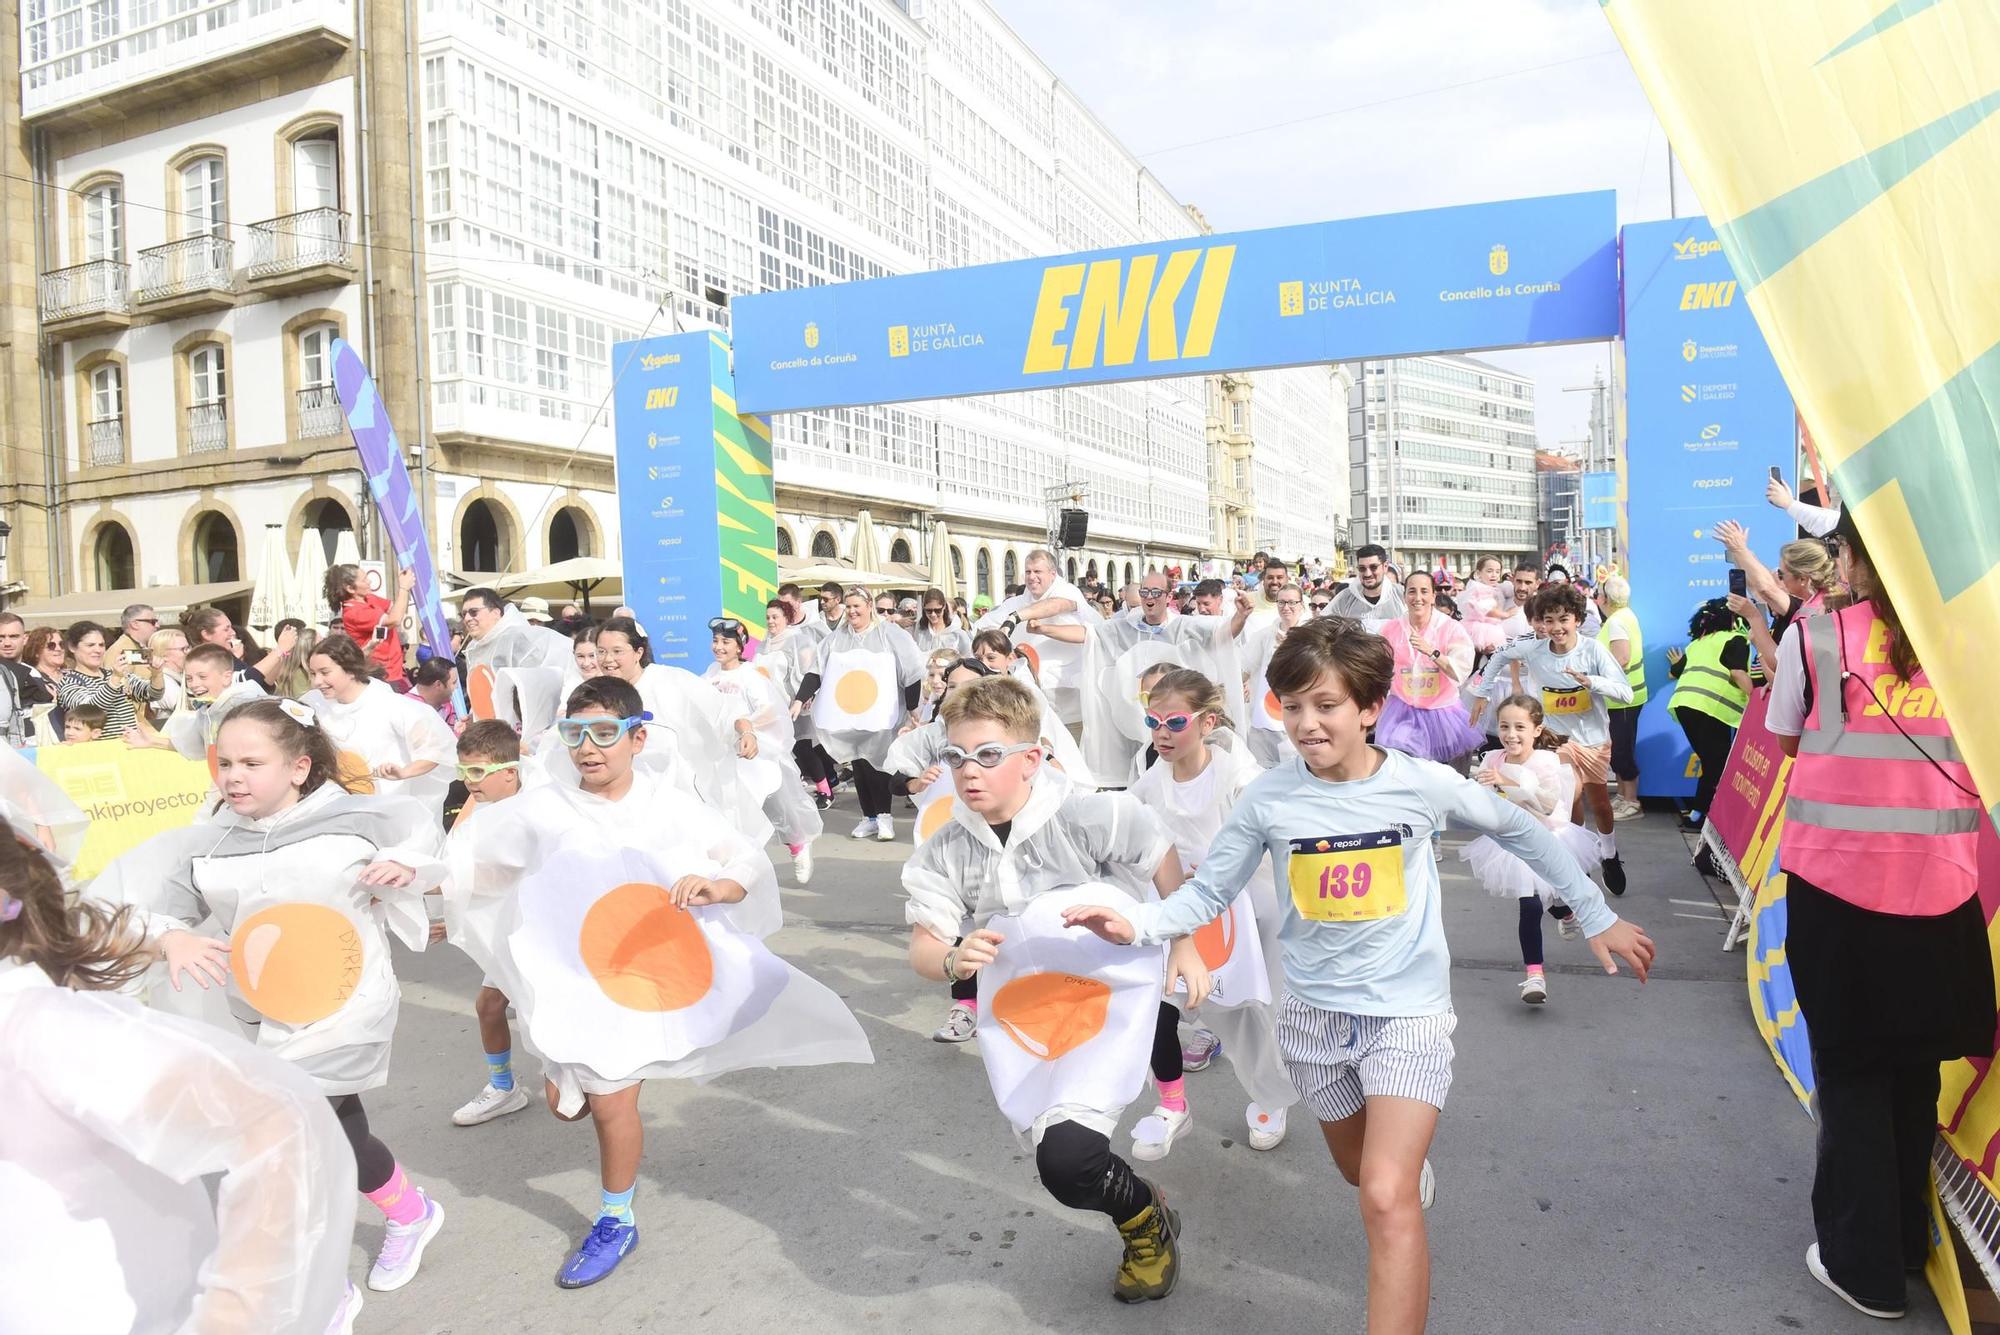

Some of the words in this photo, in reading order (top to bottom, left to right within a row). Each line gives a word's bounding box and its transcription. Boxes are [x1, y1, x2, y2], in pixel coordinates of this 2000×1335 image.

[1672, 237, 1721, 256] Vega
[1309, 278, 1361, 295] XUNTA
[1440, 287, 1491, 302] Concello
[1496, 285, 1511, 297] da
[1515, 281, 1560, 296] Coruña
[1680, 281, 1737, 310] ENKI
[1023, 245, 1237, 374] ENKI
[1309, 298, 1328, 311] DE
[1333, 291, 1396, 309] GALICIA
[913, 323, 956, 338] XUNTA
[913, 340, 928, 352] DE
[932, 334, 984, 350] GALICIA
[770, 358, 808, 370] Concello
[811, 356, 822, 366] da
[825, 352, 857, 365] Coruña
[645, 386, 679, 410] ENKI
[1693, 476, 1733, 489] repsol
[1689, 579, 1728, 587] ATREVI
[1555, 696, 1577, 708] 140
[82, 791, 213, 821] nkiproyecto.
[1333, 839, 1361, 848] repsol
[1319, 862, 1372, 899] 139
